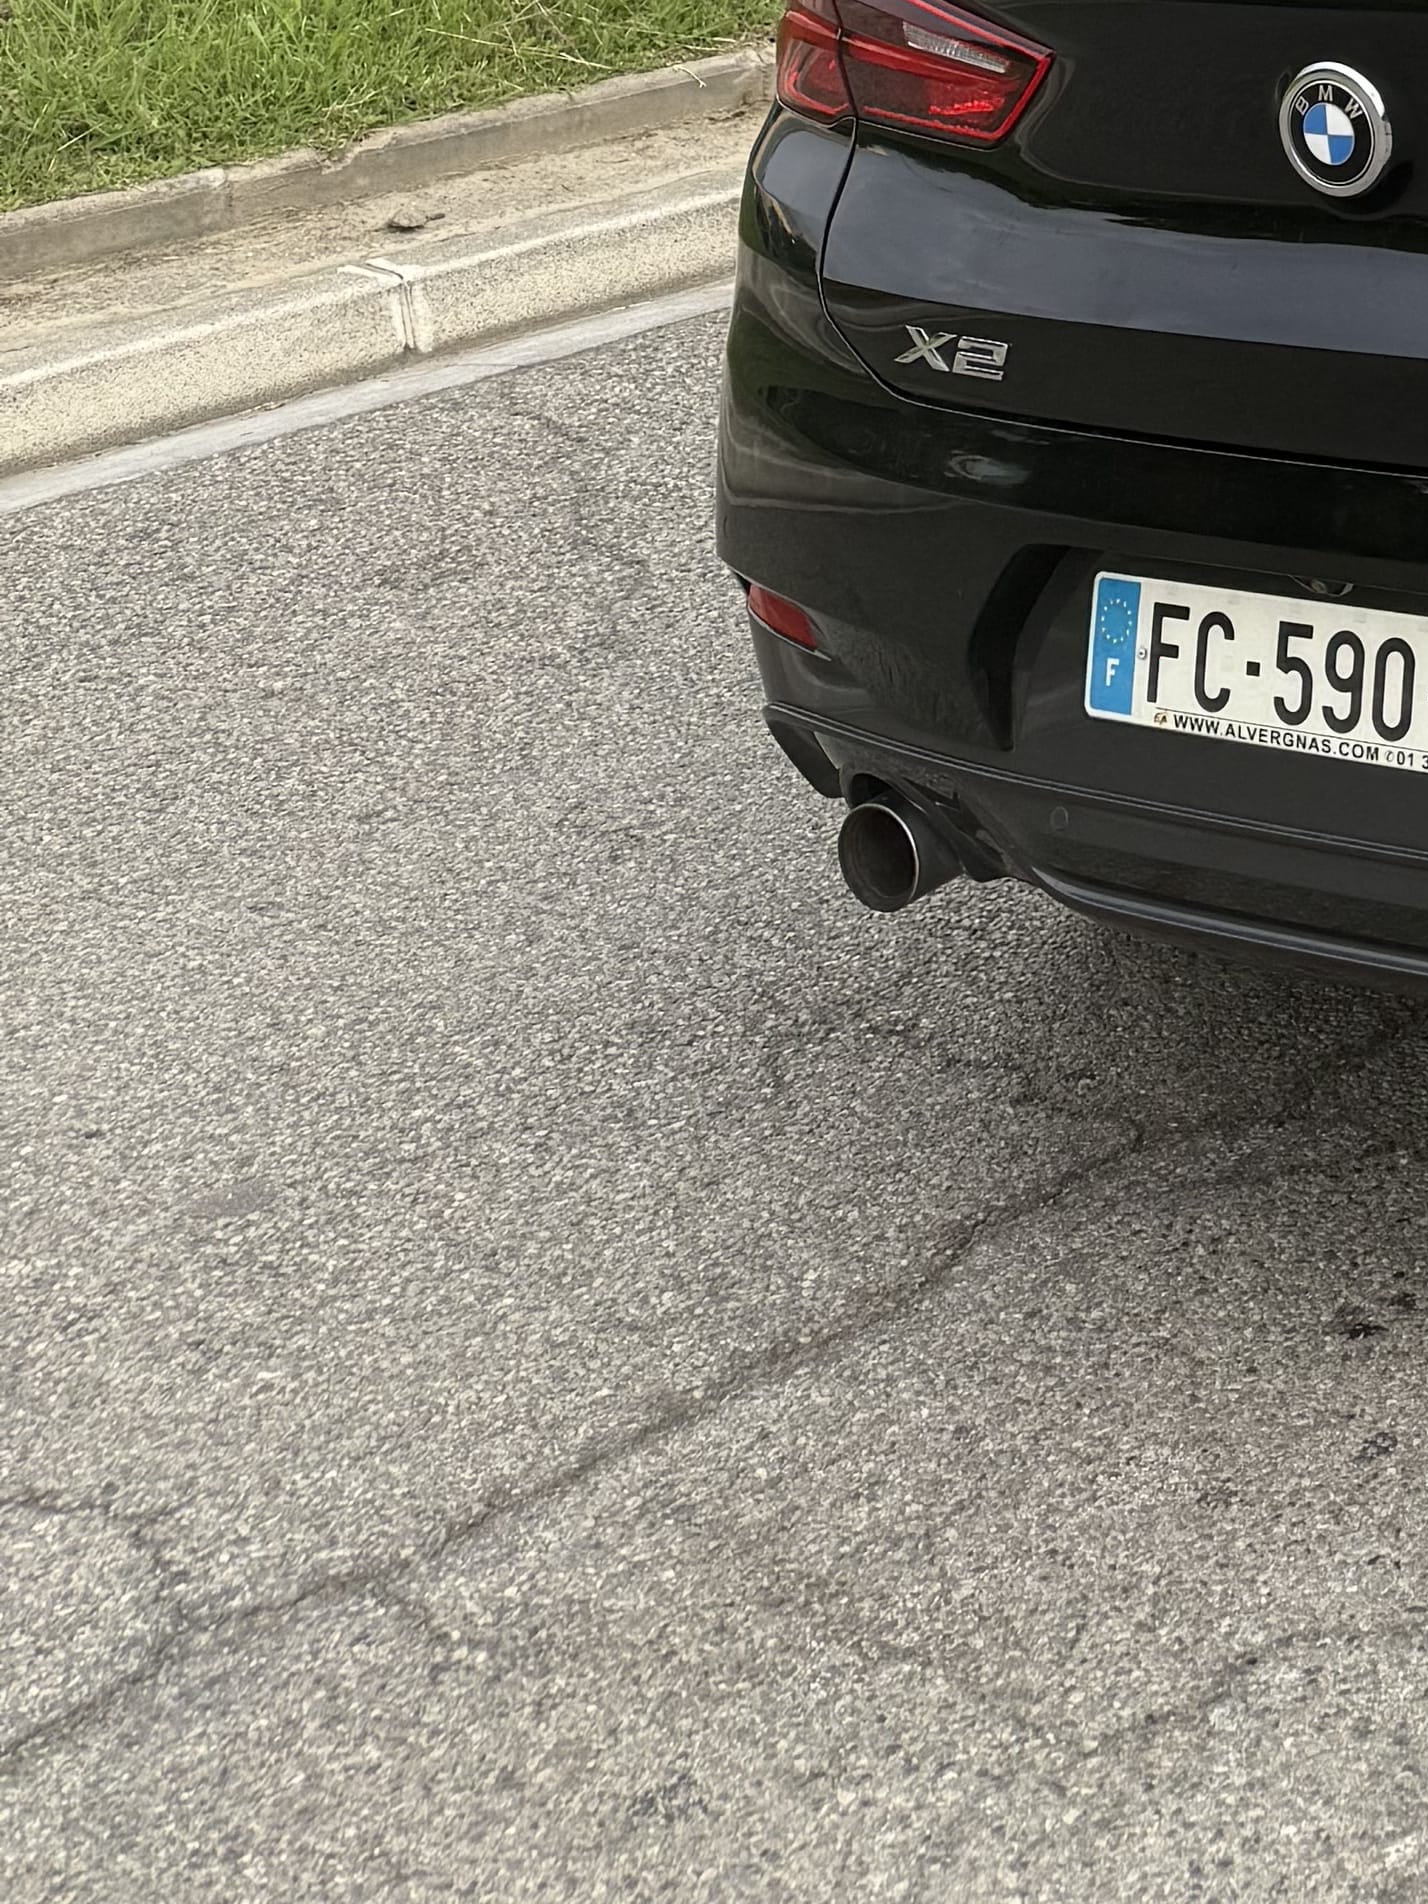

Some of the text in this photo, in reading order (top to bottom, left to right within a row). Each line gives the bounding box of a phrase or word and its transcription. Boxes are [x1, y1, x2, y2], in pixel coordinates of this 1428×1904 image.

[1295, 85, 1363, 119] BMW
[893, 324, 1008, 381] X2
[1105, 657, 1120, 687] F
[1173, 713, 1379, 762] WWW.ALVERGNAS.COM
[1396, 750, 1414, 766] 01
